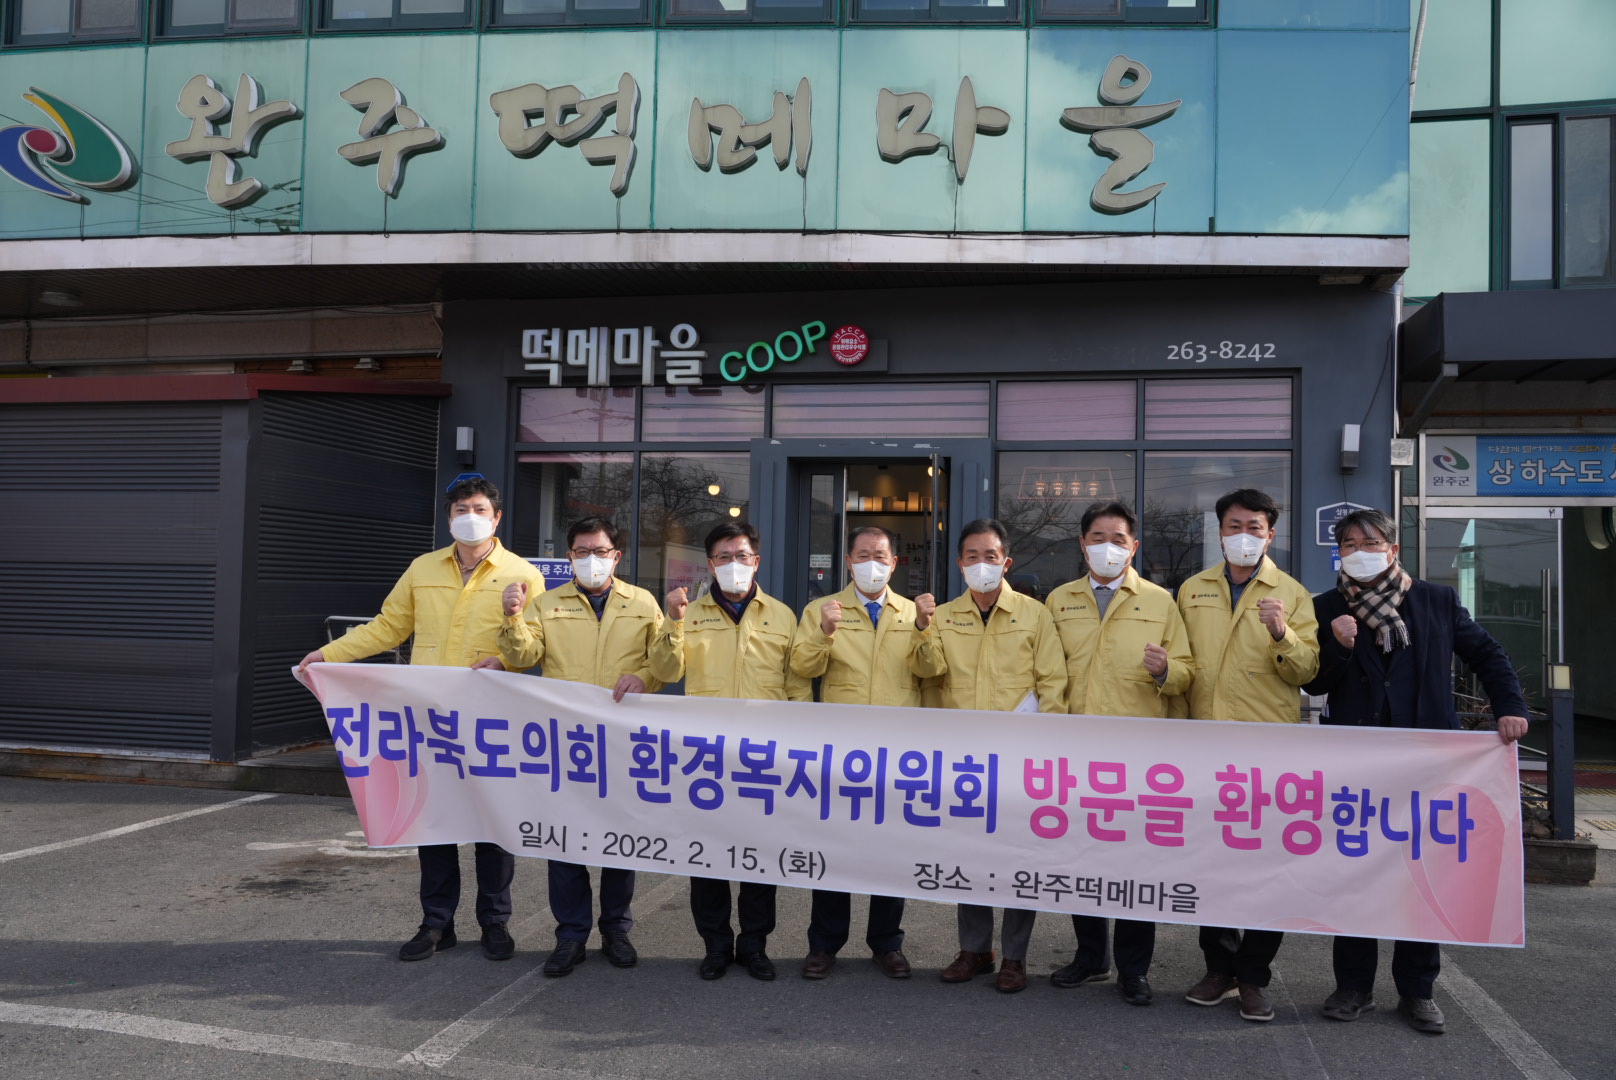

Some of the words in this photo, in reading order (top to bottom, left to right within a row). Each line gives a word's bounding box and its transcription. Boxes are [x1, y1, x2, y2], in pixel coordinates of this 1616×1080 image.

[522, 323, 708, 386] 떡메마을
[719, 320, 826, 382] COOP
[834, 326, 866, 339] HACCP
[1167, 340, 1276, 363] 263-8242
[1432, 475, 1470, 487] 완주군
[326, 702, 607, 799] 전라북도의회
[628, 725, 1000, 834] 환경복지위원회
[1022, 757, 1194, 847] 방문을
[1213, 764, 1476, 864] 환영합니다
[518, 821, 567, 853] 일시
[602, 831, 675, 865] 2022.
[726, 845, 766, 874] 15.
[778, 847, 826, 881] (화)
[913, 863, 973, 891] 장소
[1011, 870, 1200, 914] 완주떡메마을
